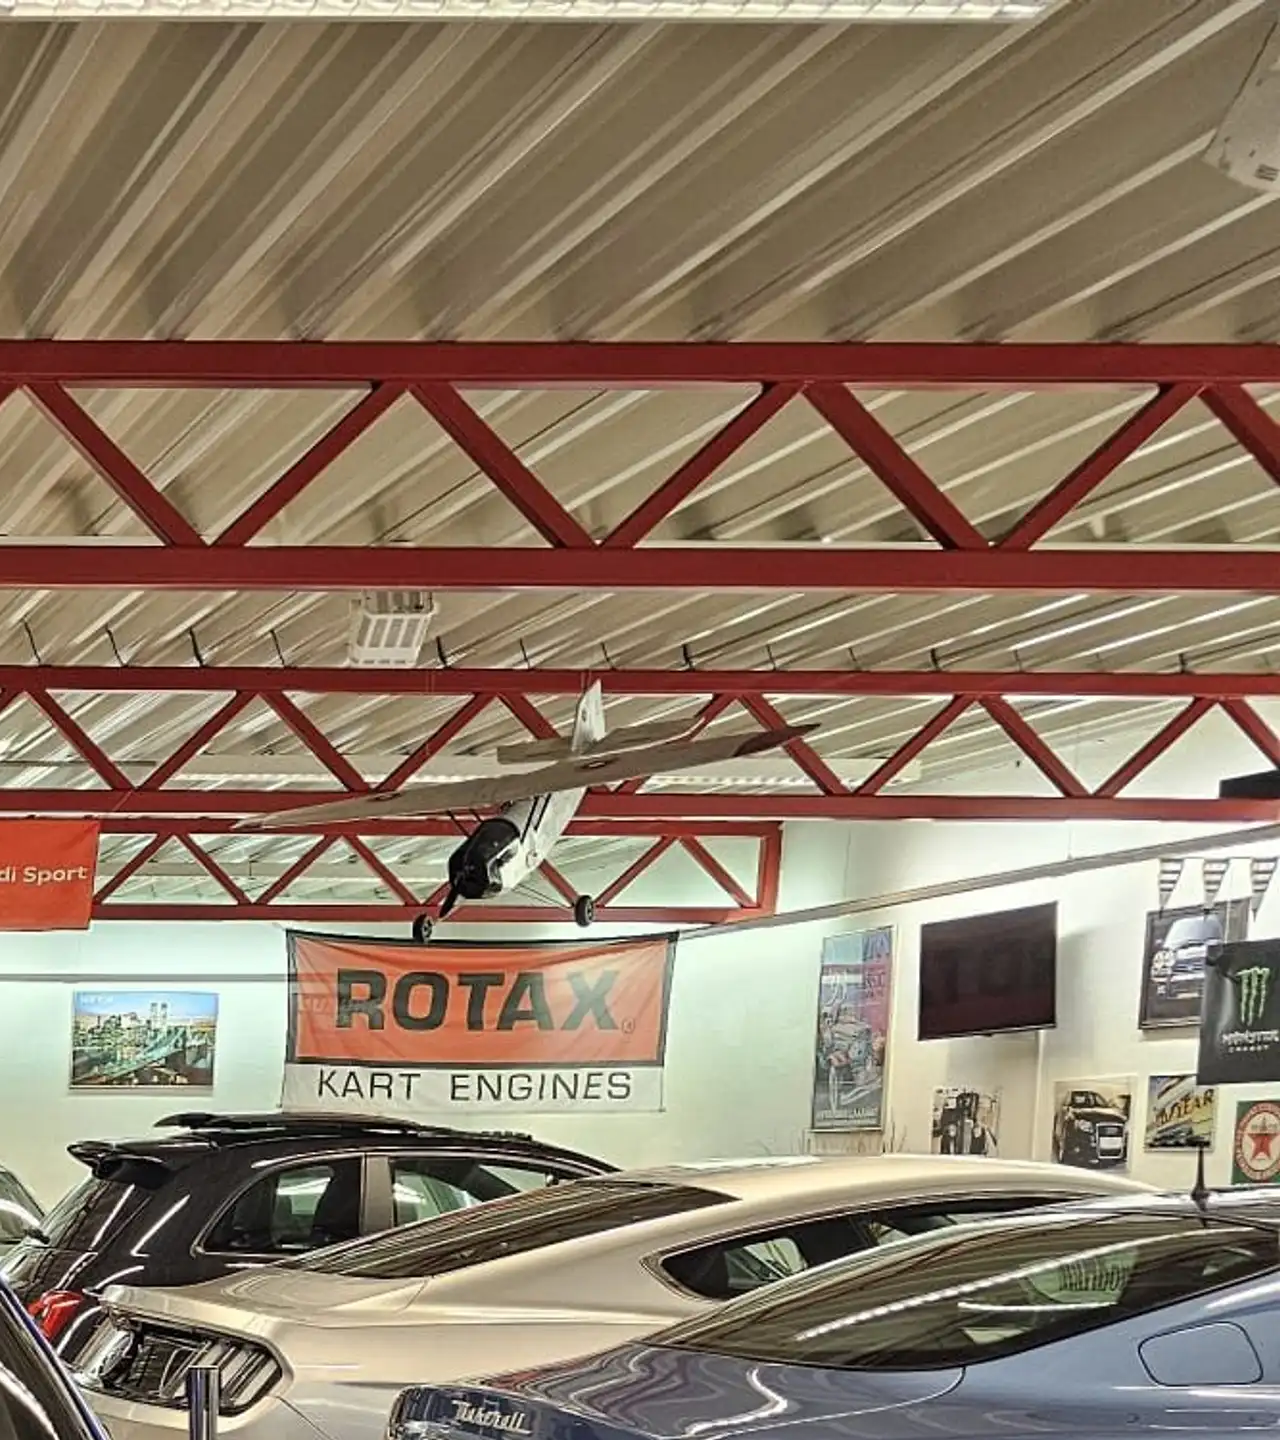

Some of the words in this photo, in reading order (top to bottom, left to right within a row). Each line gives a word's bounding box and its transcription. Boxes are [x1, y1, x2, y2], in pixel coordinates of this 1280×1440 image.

[23, 865, 88, 888] Sport
[336, 968, 621, 1033] ROTAX
[318, 1069, 422, 1100] KART
[450, 1071, 631, 1100] ENGINES
